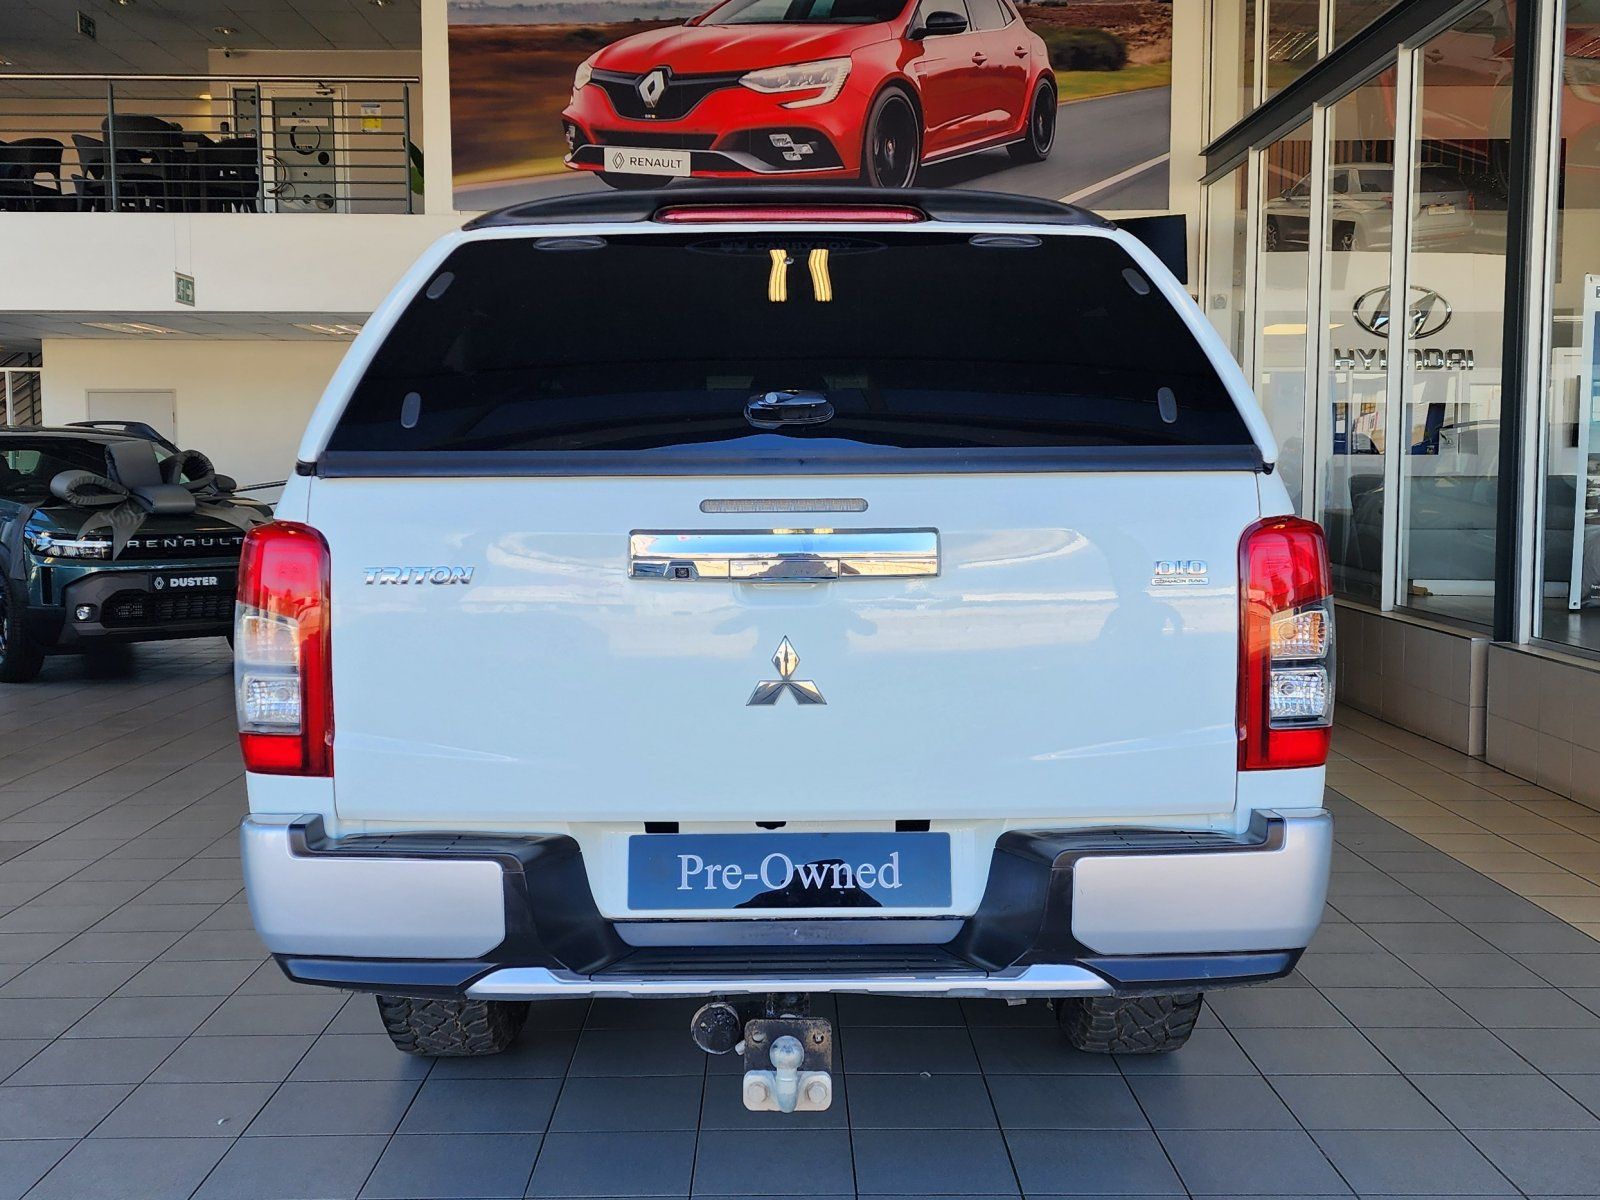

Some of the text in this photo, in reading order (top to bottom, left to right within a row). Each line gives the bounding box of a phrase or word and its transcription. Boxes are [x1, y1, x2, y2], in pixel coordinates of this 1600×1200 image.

[629, 156, 683, 169] RENAULT
[127, 537, 243, 548] RENAULT
[169, 576, 218, 588] DUSTER
[363, 566, 475, 586] TRITON
[676, 851, 903, 890] Pre-Owned
